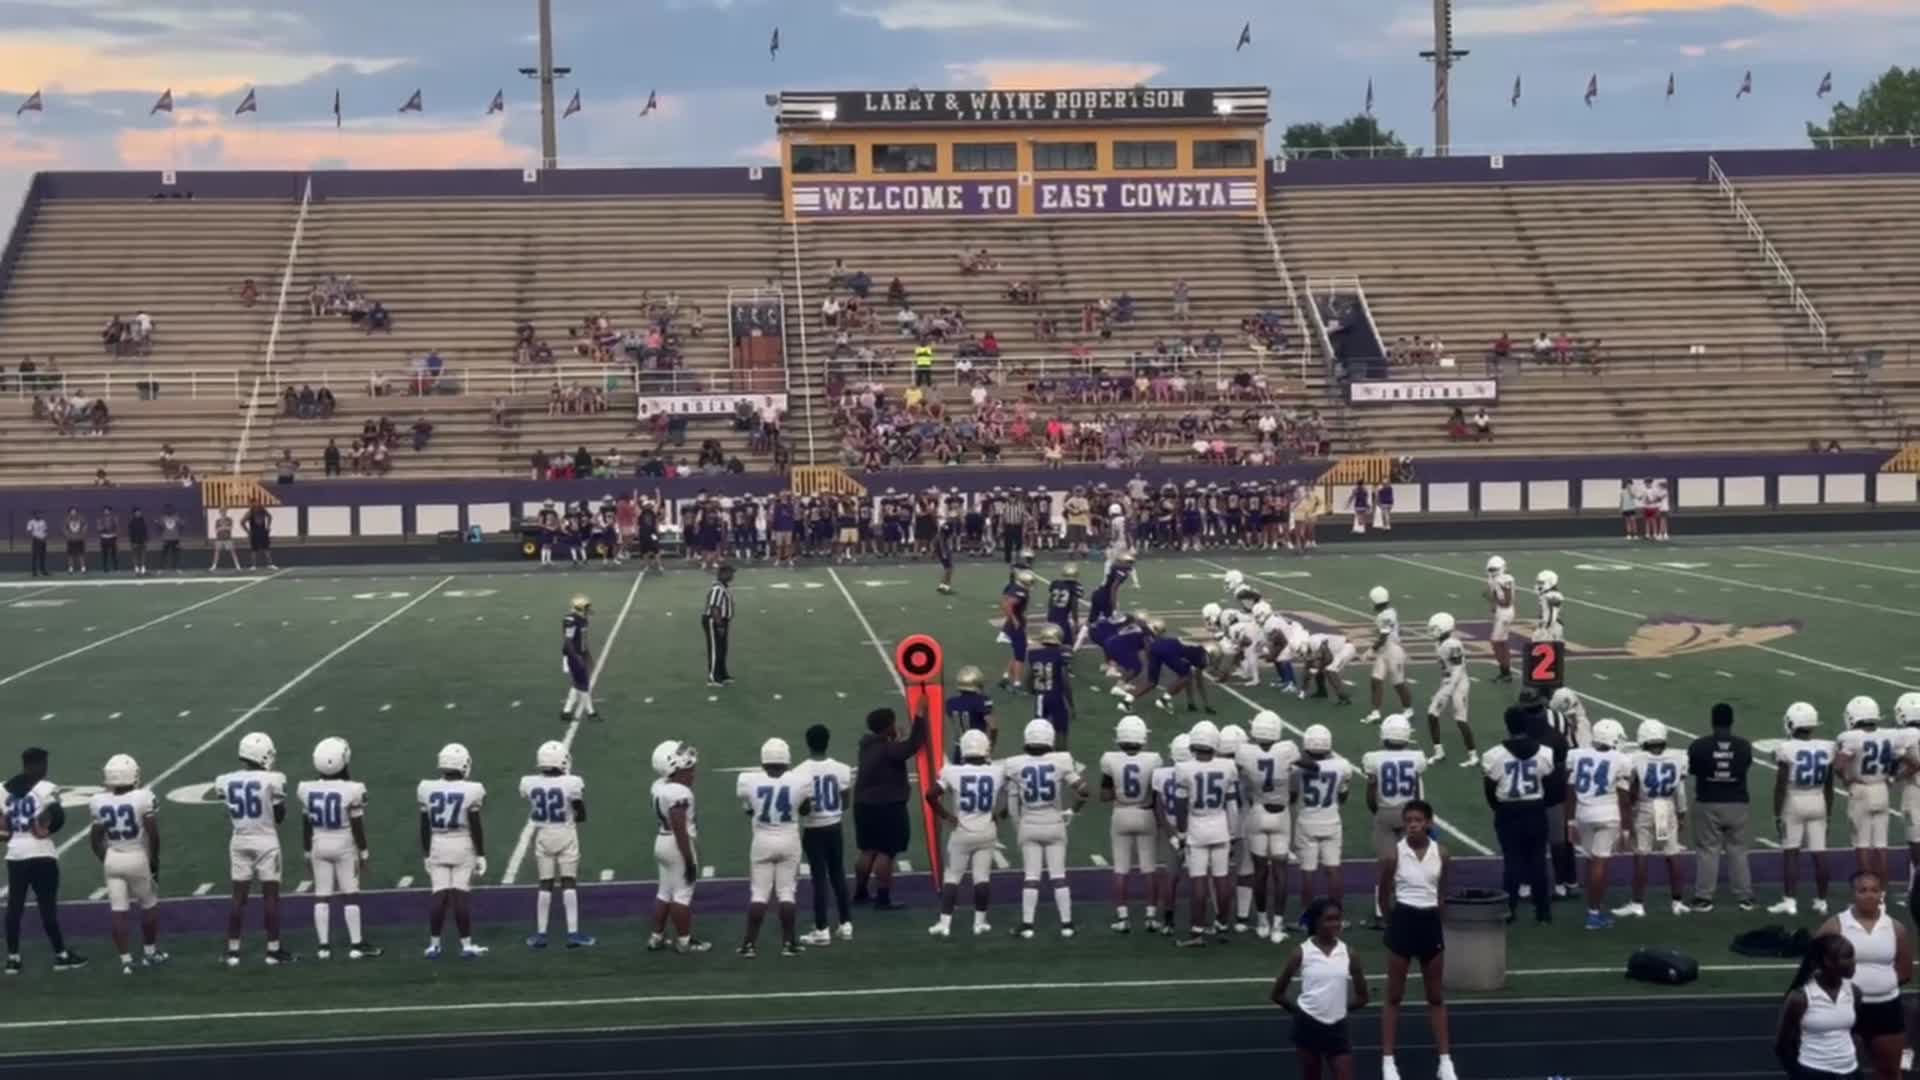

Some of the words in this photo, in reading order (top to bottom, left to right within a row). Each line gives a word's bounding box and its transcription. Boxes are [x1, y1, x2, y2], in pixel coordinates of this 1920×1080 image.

[866, 92, 936, 110] LARRY
[945, 93, 959, 110] &
[971, 92, 1047, 110] WAYNE
[1056, 89, 1186, 109] ROBERTSON
[820, 185, 963, 213] WELCOME
[979, 185, 1012, 210] TO
[1041, 184, 1107, 209] EAST
[1120, 182, 1226, 208] COWETA
[1531, 643, 1556, 680] 2
[1021, 764, 1056, 802] 35
[1123, 763, 1141, 798] 6
[1255, 759, 1274, 792] 7
[1381, 761, 1415, 797] 85
[1504, 761, 1538, 797] 75
[1576, 757, 1611, 796] 64
[1644, 762, 1677, 798] 42
[1796, 749, 1829, 786] 26
[227, 780, 263, 819] 56
[530, 787, 566, 823] 32
[757, 785, 792, 823] 74
[960, 775, 994, 813] 58
[1194, 771, 1224, 809] 15
[1302, 770, 1338, 808] 57
[100, 804, 139, 841] 23
[308, 791, 343, 830] 50
[430, 791, 465, 829] 27
